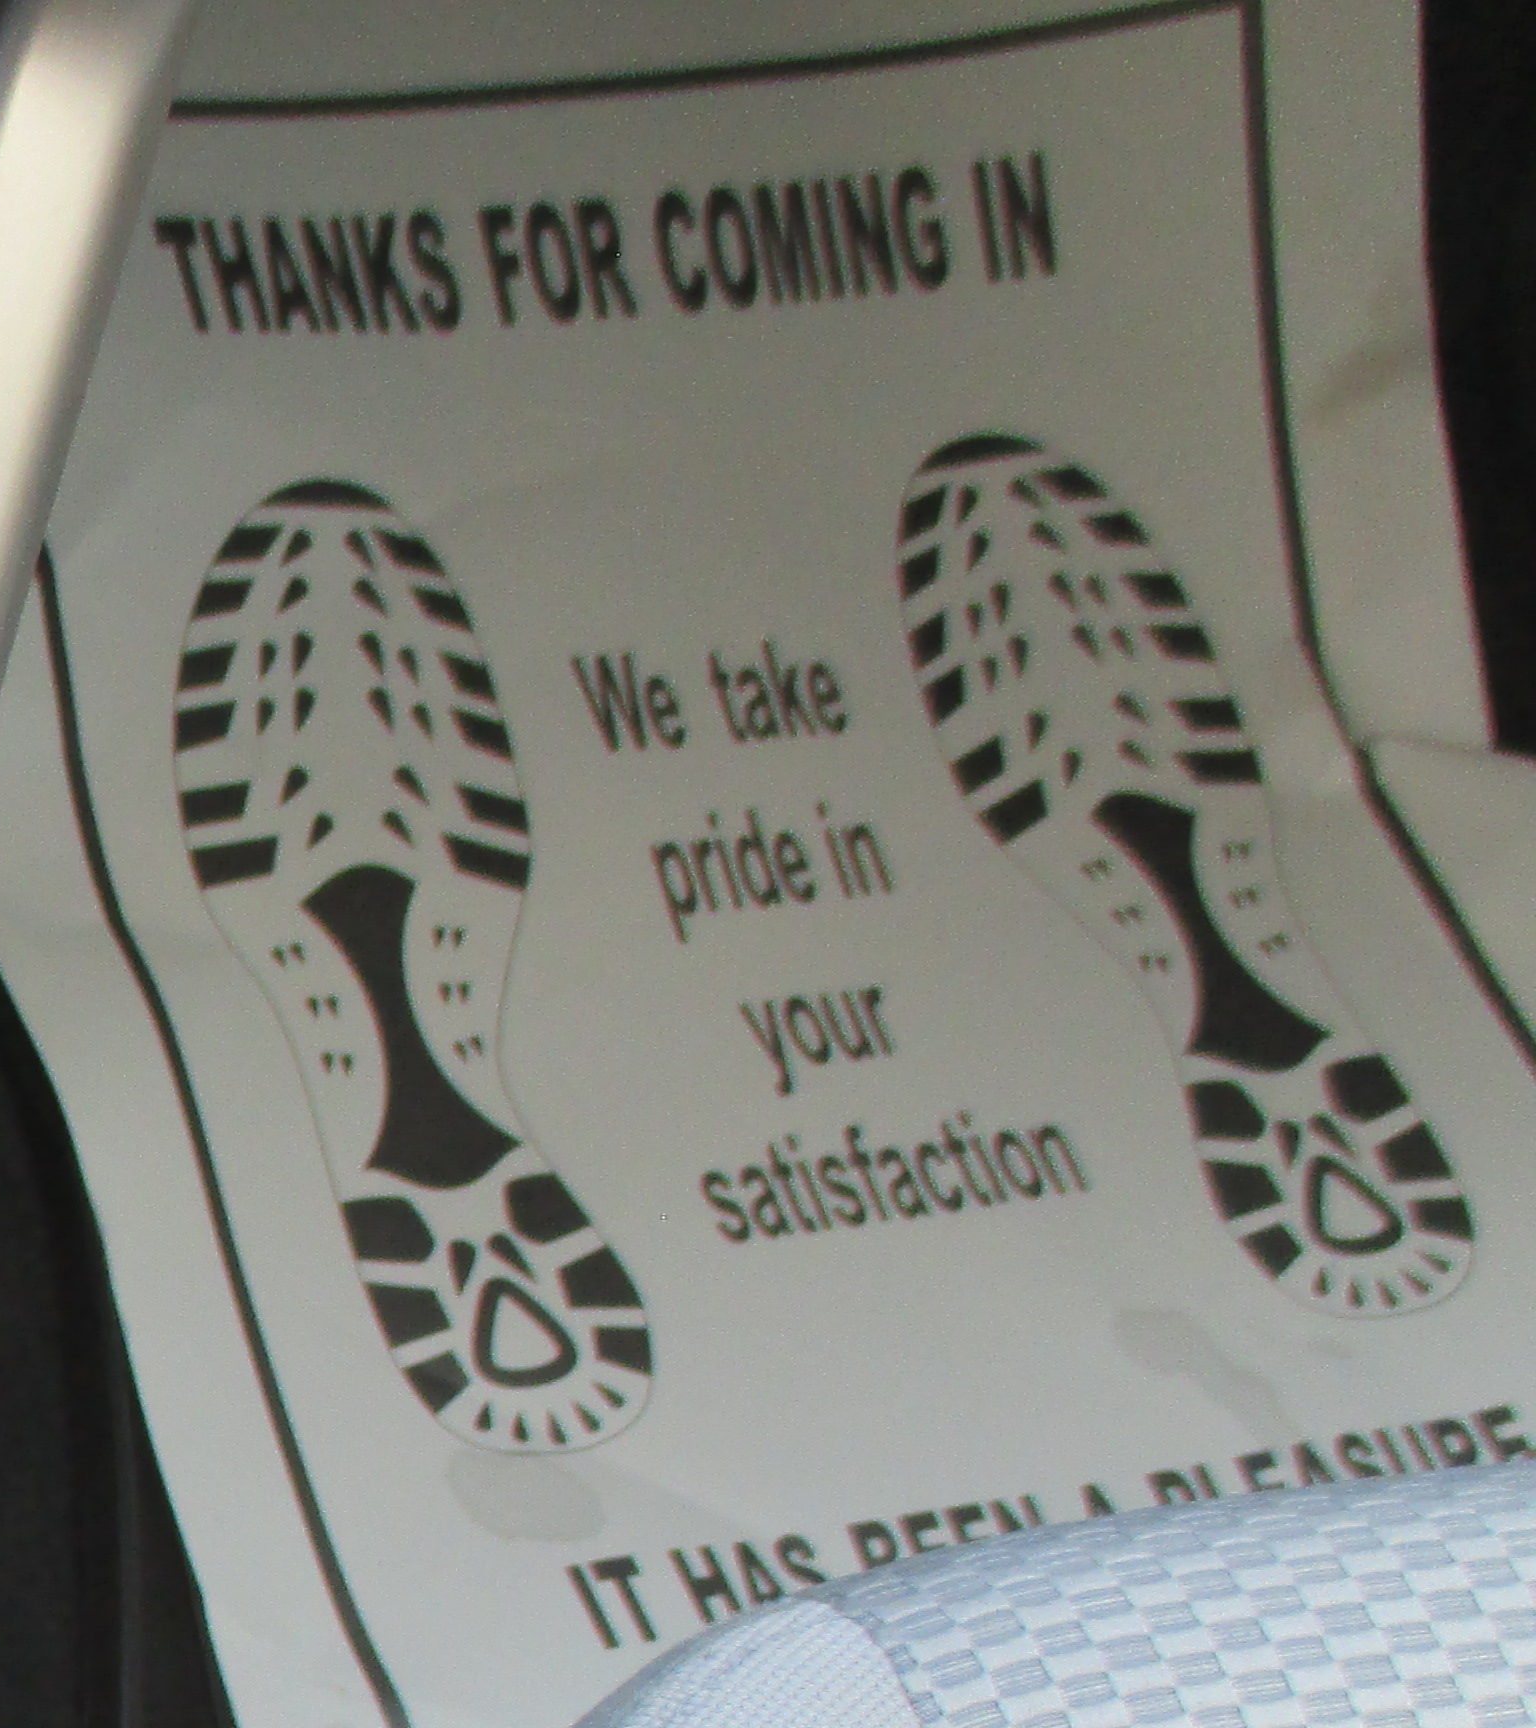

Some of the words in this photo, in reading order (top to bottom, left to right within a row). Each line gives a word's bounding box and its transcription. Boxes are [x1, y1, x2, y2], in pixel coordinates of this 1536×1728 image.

[153, 208, 462, 336] THANKS
[478, 194, 639, 327] FOR
[653, 165, 951, 316] COMING
[970, 150, 1060, 284] IN
[571, 649, 687, 754] We
[709, 636, 850, 743] take
[650, 807, 818, 944] pride
[817, 799, 895, 899] in
[739, 983, 895, 1097] your
[701, 1110, 1089, 1243] satisfaction
[564, 1554, 658, 1650] IT
[667, 1531, 829, 1624] HAS
